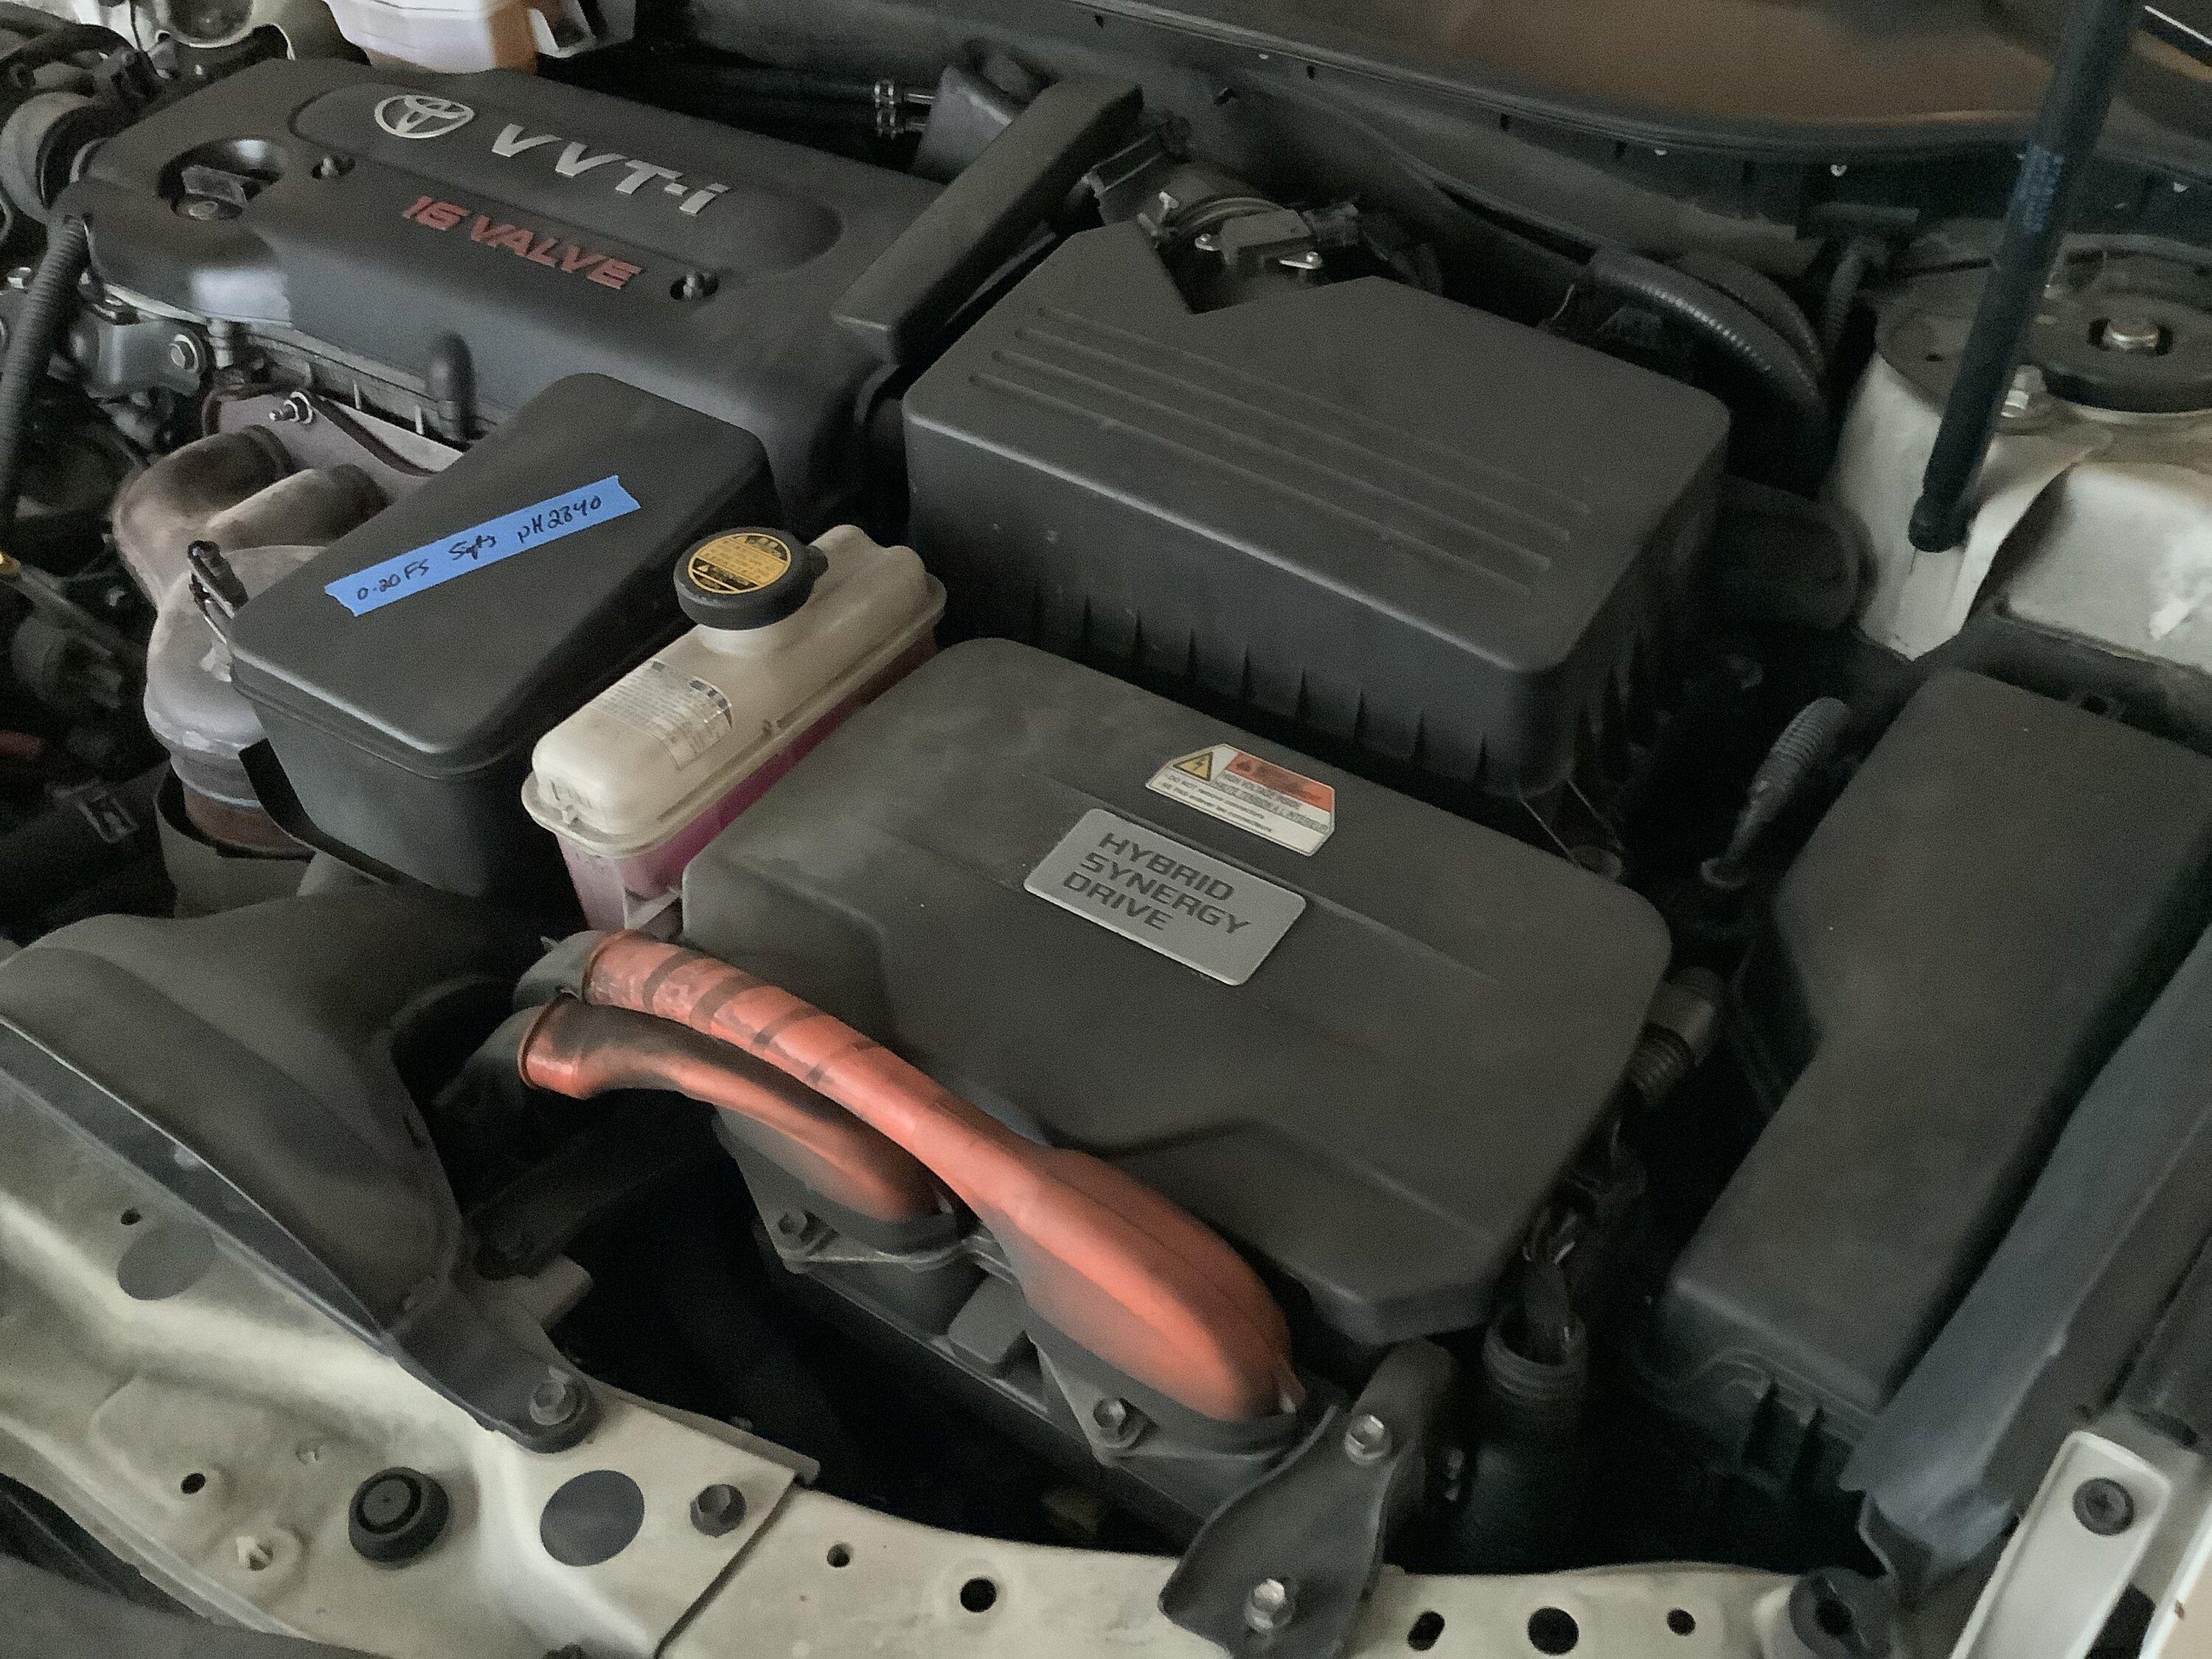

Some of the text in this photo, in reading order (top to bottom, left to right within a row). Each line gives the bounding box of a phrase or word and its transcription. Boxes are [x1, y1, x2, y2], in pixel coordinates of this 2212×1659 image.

[491, 123, 731, 216] VVT-i
[403, 195, 643, 290] 16 VALVE
[1062, 872, 1174, 931] DRIVE
[1081, 852, 1252, 934] SYNERGY
[1098, 832, 1235, 901] HYBRID
